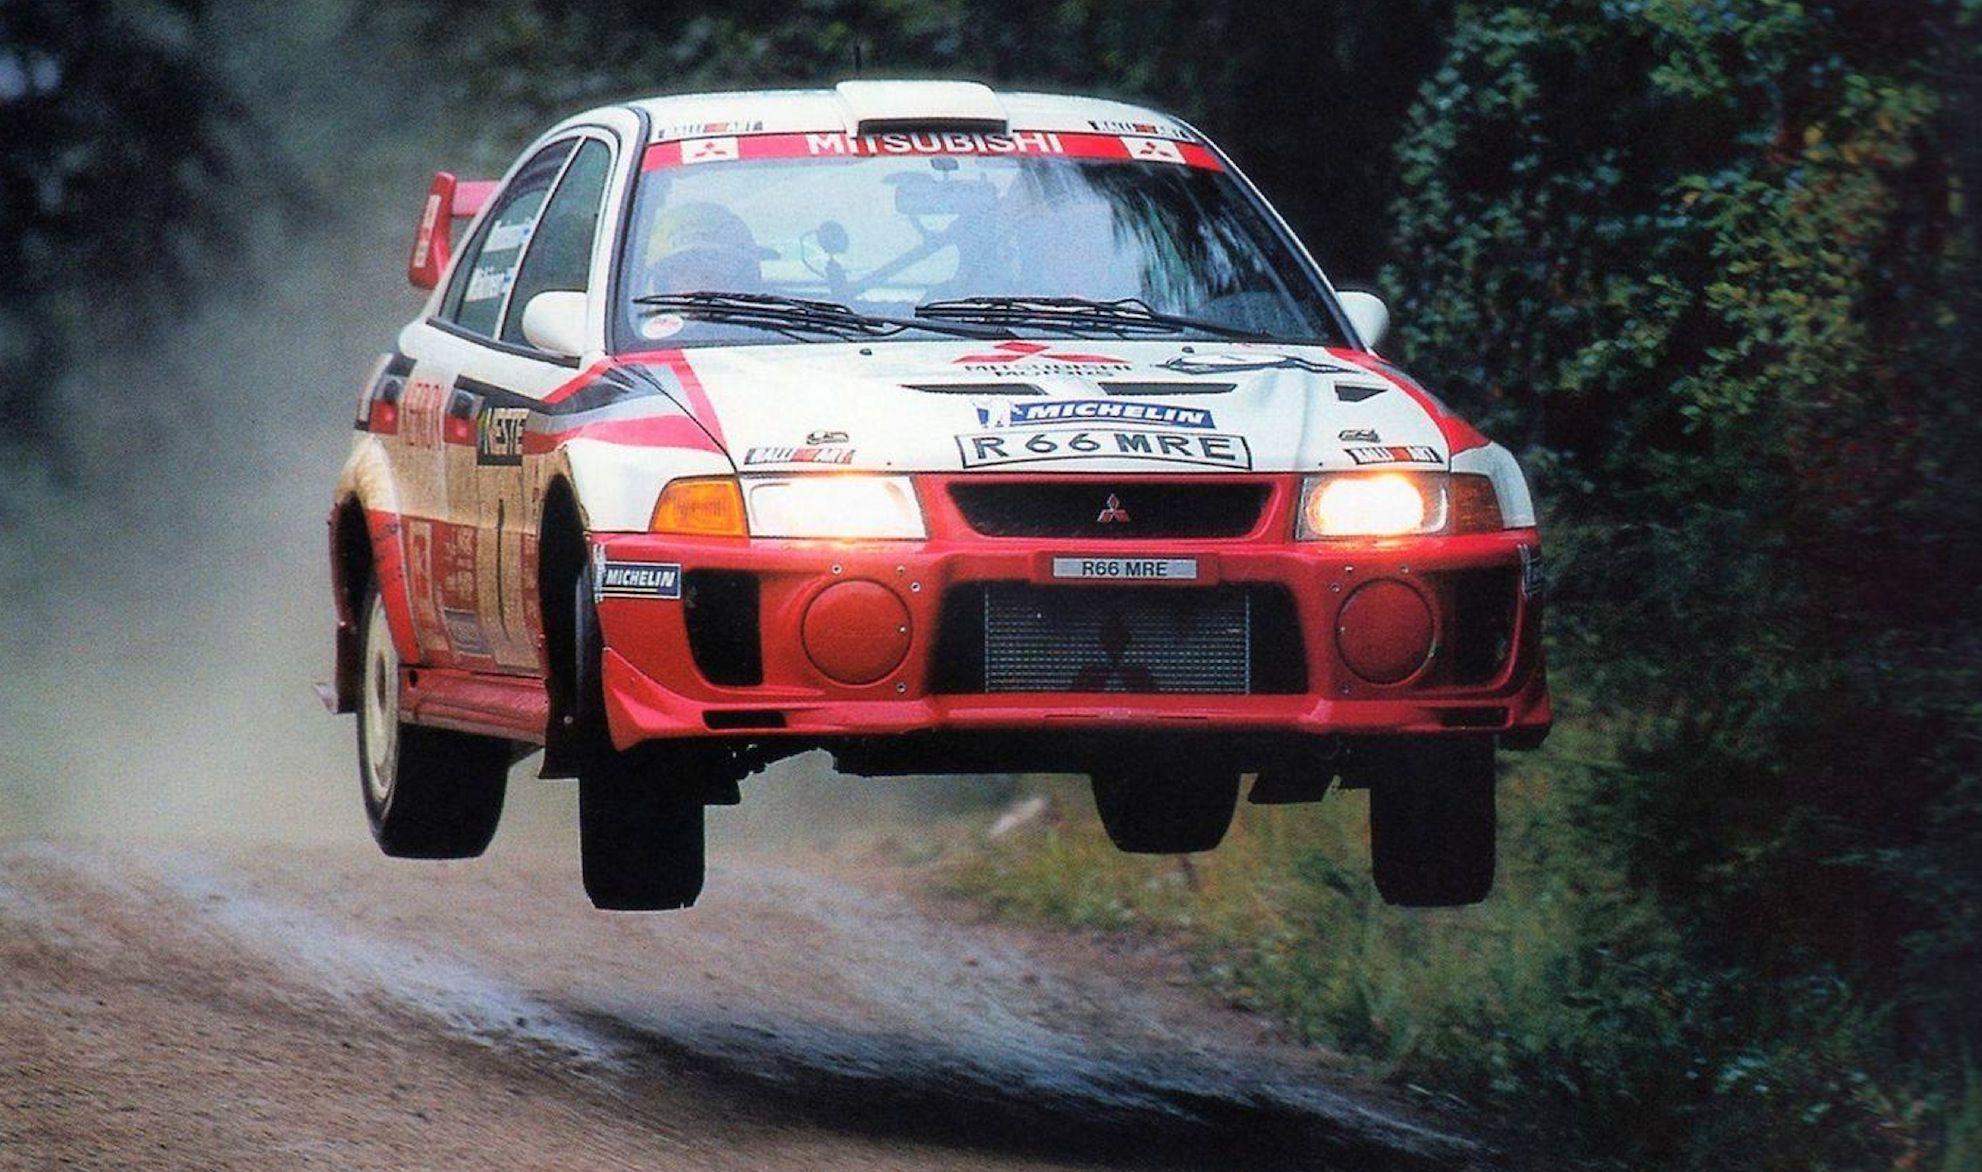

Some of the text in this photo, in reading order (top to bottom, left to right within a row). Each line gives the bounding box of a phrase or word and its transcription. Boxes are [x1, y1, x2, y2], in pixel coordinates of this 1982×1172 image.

[804, 132, 1064, 154] MITSUBISHI
[1025, 402, 1206, 425] MICHELIN
[1114, 432, 1236, 461] MRE
[605, 568, 676, 587] MICHELIN
[1081, 561, 1168, 576] R66 MRE
